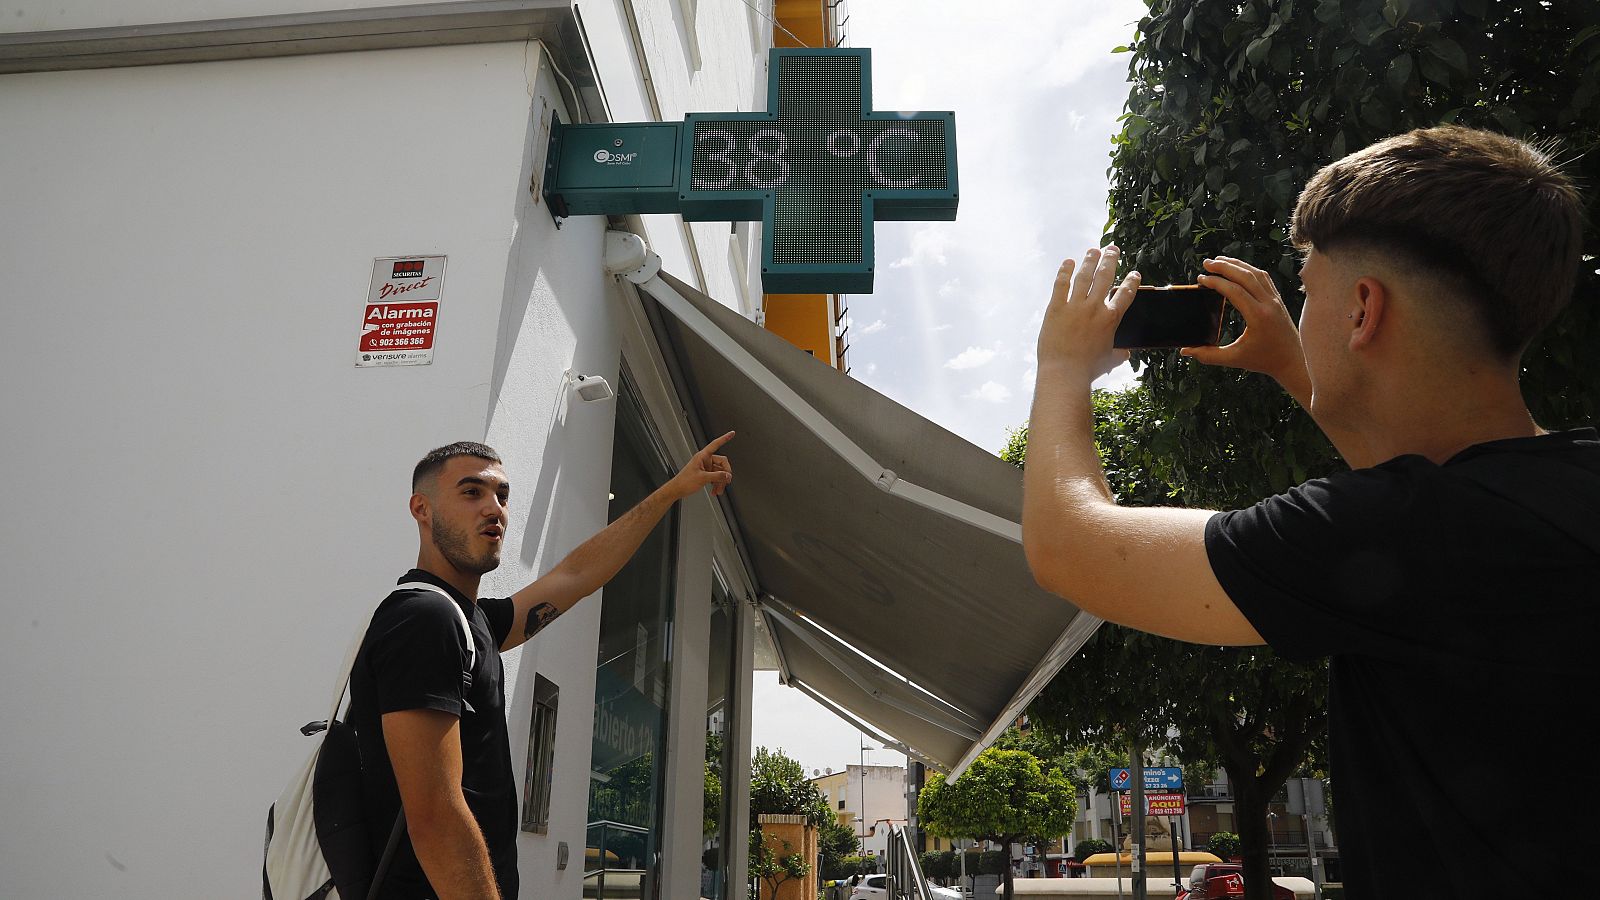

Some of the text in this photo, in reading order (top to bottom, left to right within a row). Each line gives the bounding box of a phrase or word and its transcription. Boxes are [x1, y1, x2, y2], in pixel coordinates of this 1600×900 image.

[692, 128, 920, 189] 38 °C
[379, 276, 436, 299] Direct
[367, 306, 433, 320] Alarma
[396, 321, 432, 329] grabación
[392, 328, 431, 336] imágenes
[410, 337, 425, 345] 366
[594, 696, 635, 756] abierto
[1150, 800, 1181, 808] AQUÍ
